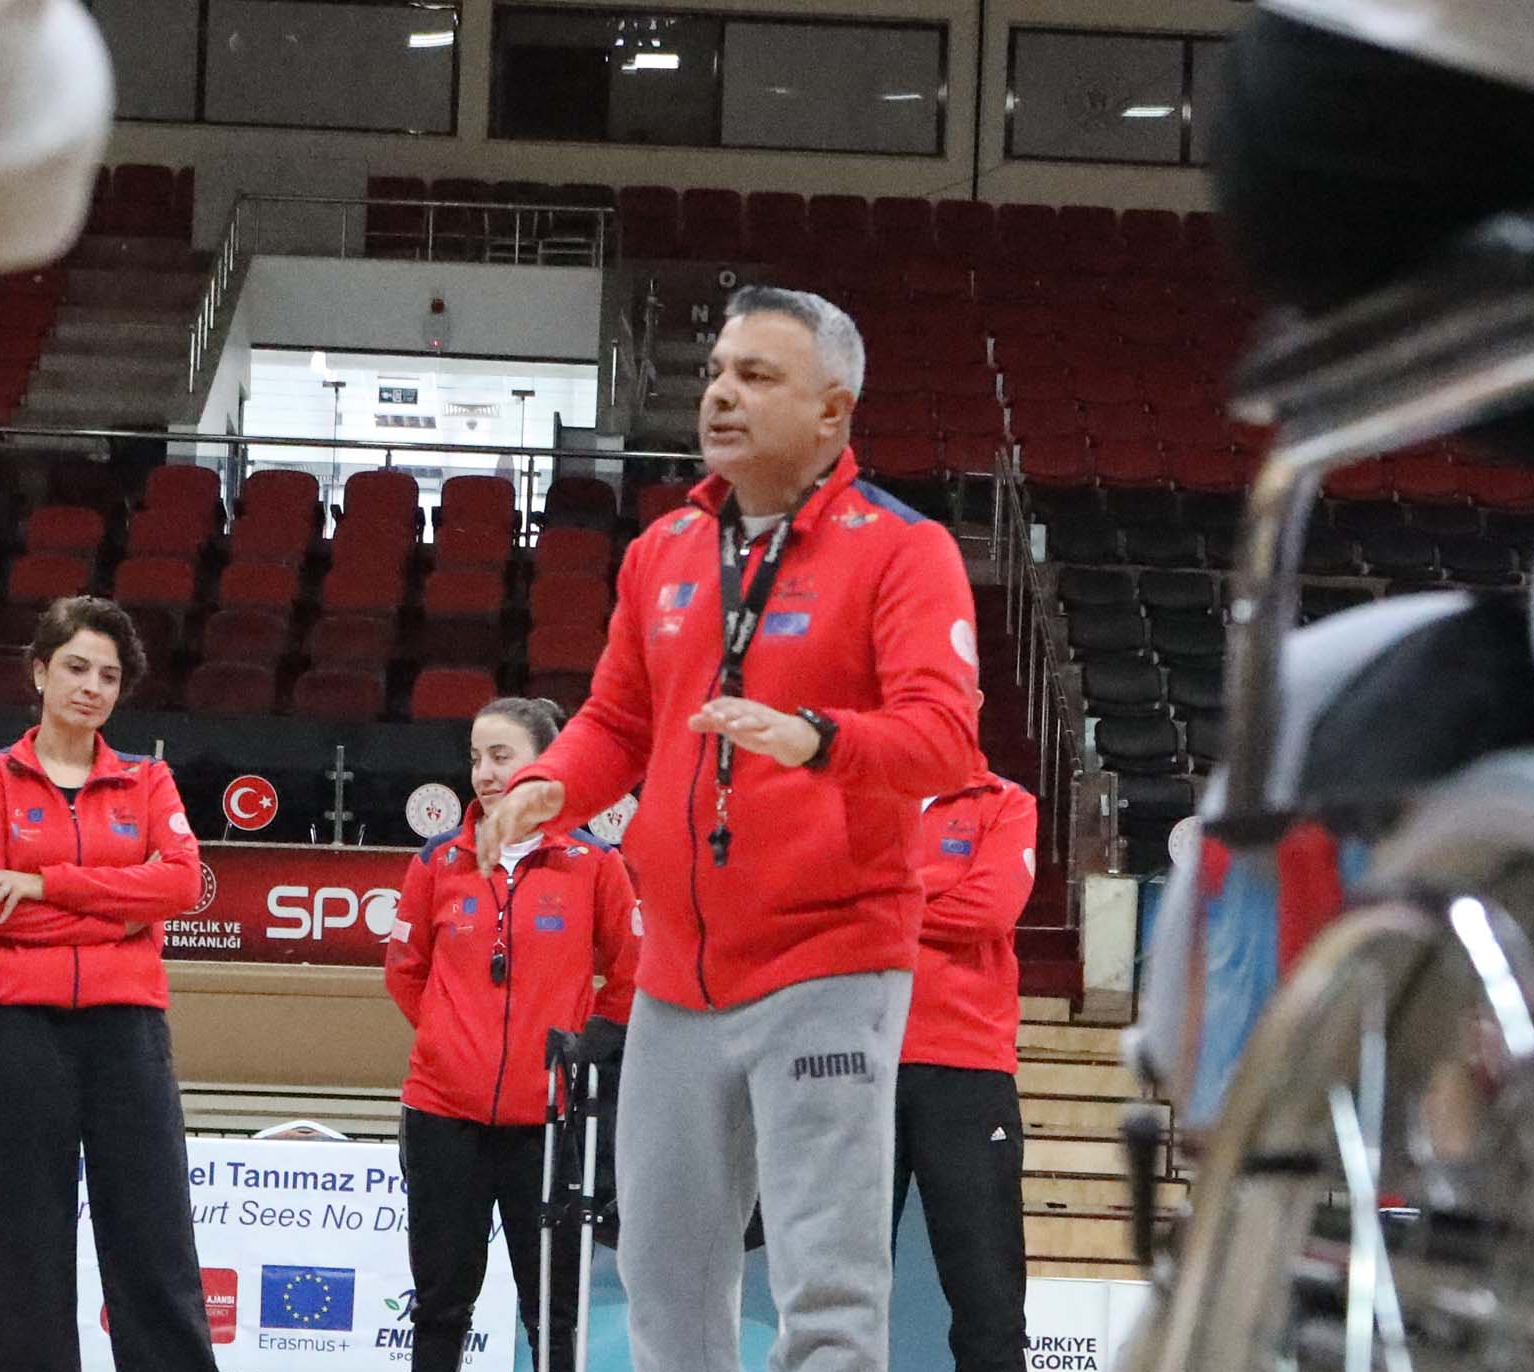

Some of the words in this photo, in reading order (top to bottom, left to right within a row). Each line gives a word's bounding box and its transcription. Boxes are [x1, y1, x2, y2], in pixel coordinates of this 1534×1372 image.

[224, 921, 242, 934] VE
[794, 1051, 867, 1081] PUMA
[227, 1161, 356, 1193] Tanımaz
[191, 1200, 230, 1226] urt
[238, 1199, 312, 1229] Sees
[321, 1203, 364, 1232] No
[258, 1332, 351, 1353] Erasmus+
[389, 1352, 413, 1362] SPO
[1031, 1354, 1098, 1371] GORTA
